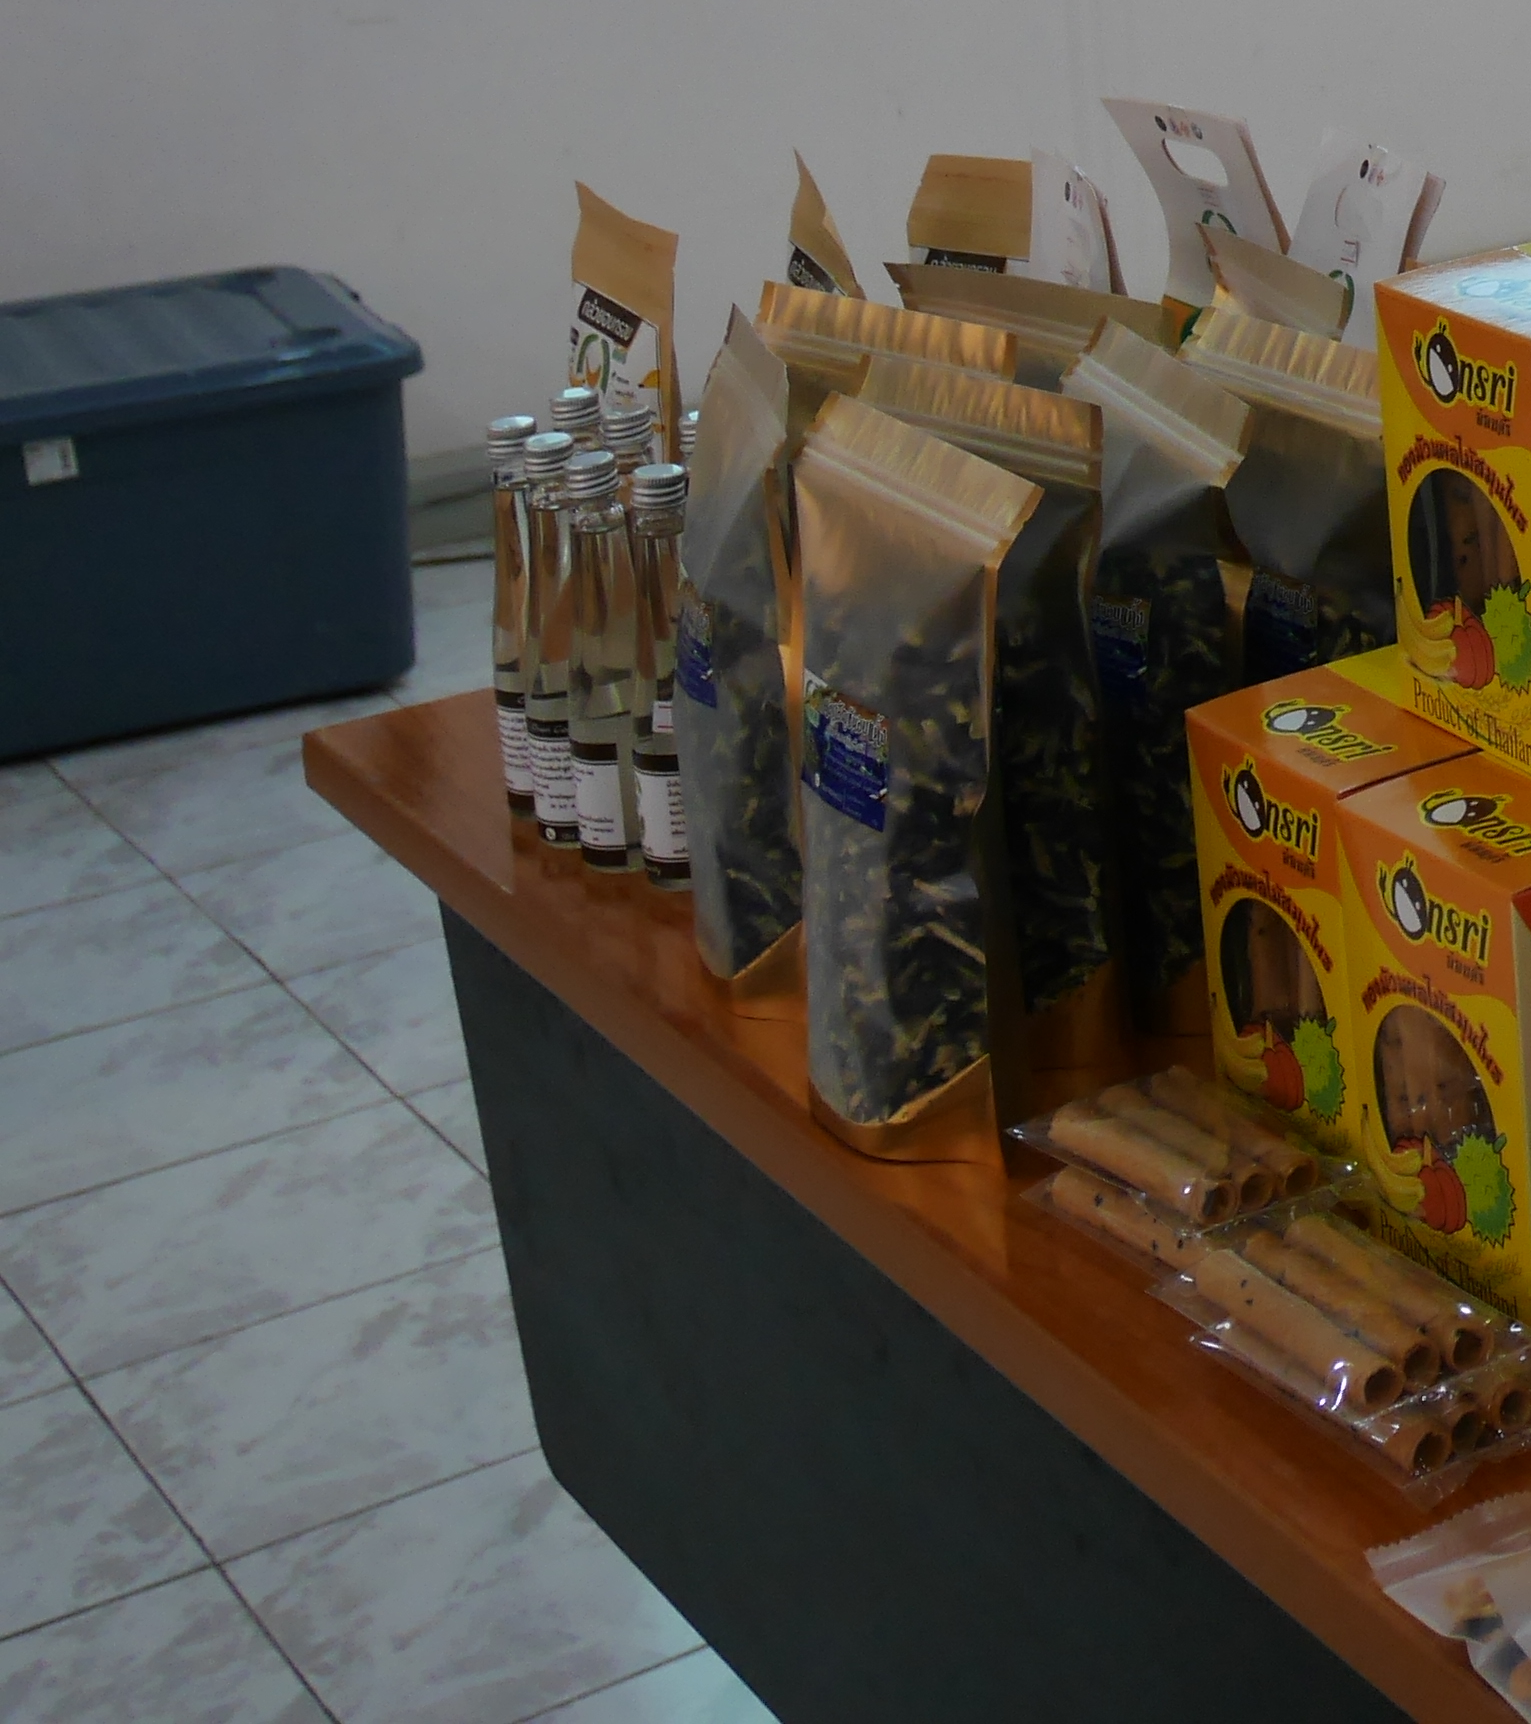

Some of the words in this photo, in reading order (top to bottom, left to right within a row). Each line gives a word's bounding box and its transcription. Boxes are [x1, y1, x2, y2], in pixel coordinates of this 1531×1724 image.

[1420, 326, 1516, 414] Onsri
[1266, 702, 1393, 760] Onsri
[1413, 677, 1462, 731] Product
[1466, 707, 1480, 741] of
[1224, 766, 1320, 856] Onsri
[1380, 864, 1490, 960] Onsri
[1380, 1208, 1430, 1270] Product
